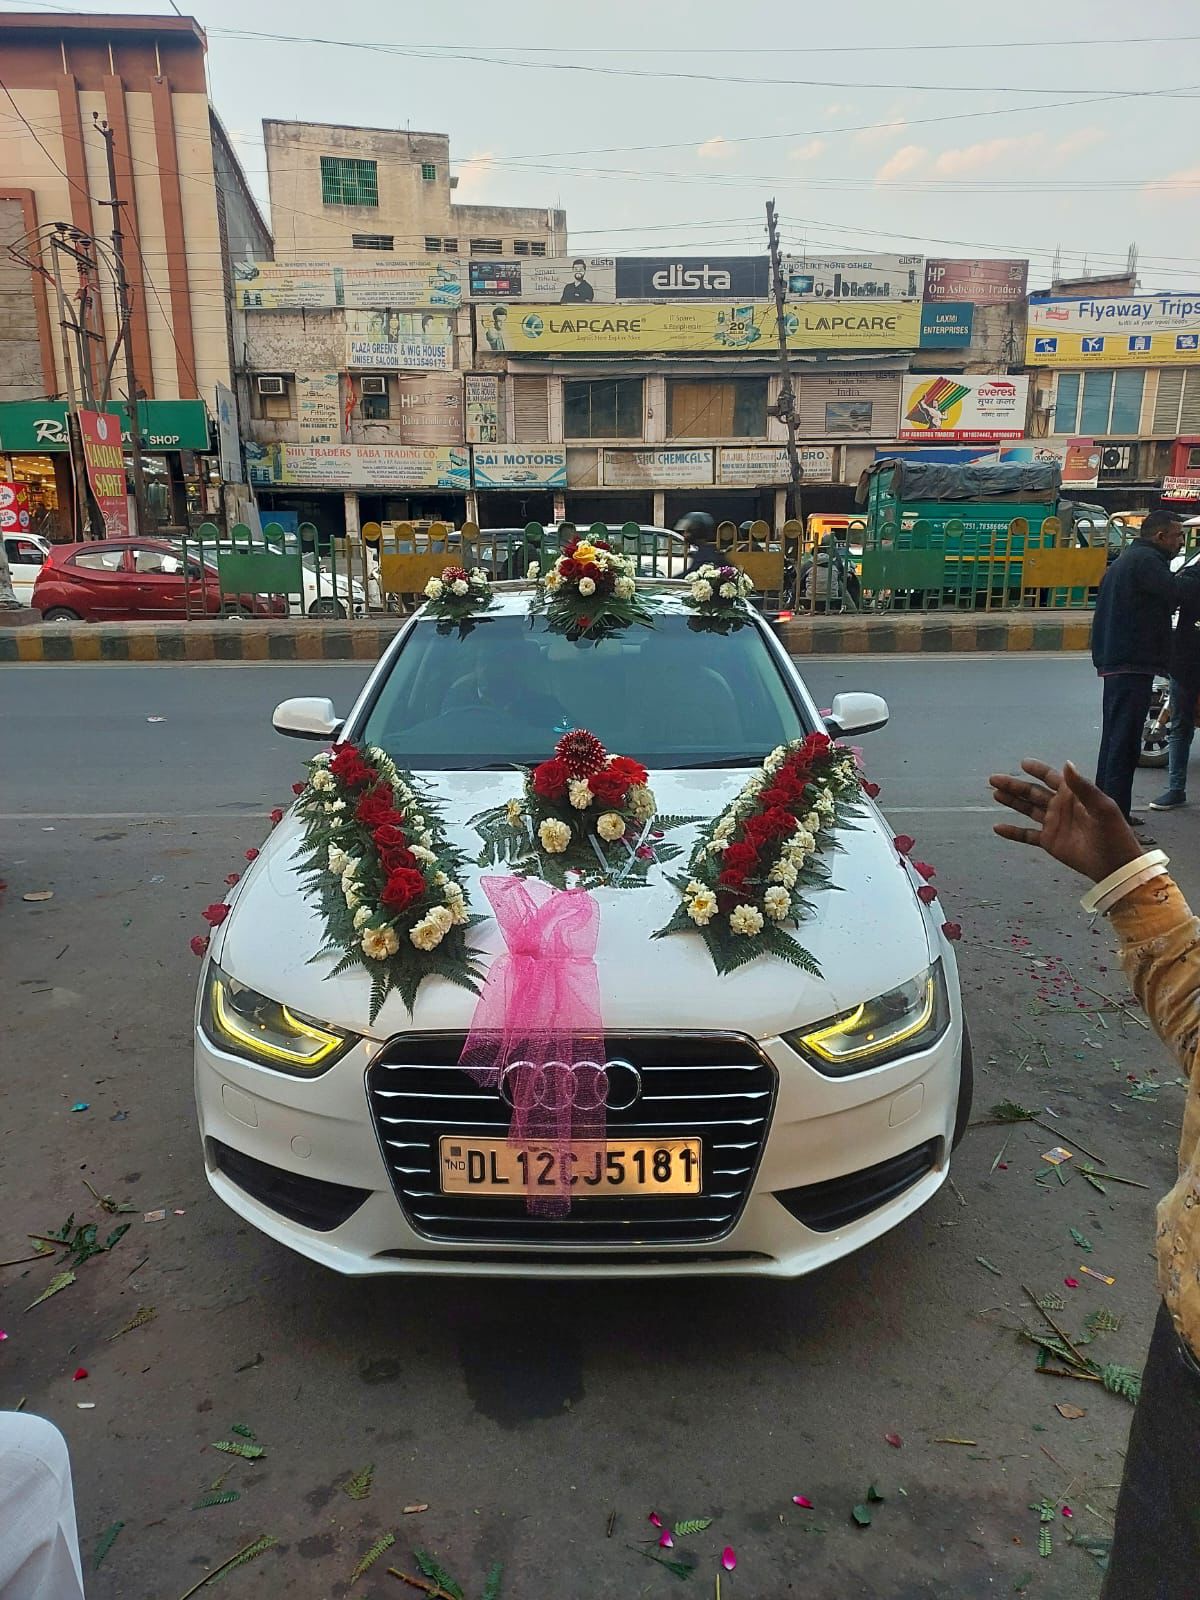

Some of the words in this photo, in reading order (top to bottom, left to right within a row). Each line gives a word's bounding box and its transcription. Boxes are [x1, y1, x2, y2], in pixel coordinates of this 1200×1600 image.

[590, 258, 614, 266] elista
[652, 264, 730, 290] elista
[928, 267, 945, 281] HP
[929, 284, 945, 294] Om
[947, 284, 985, 294] Asbestos
[989, 284, 1022, 294] Traders
[1079, 302, 1153, 322] Flyaway
[1158, 299, 1200, 318] Trips
[805, 317, 896, 330] LAPCARE
[936, 315, 958, 323] LAXMI
[550, 319, 641, 333] LAPCARE
[729, 322, 745, 331] 20
[923, 326, 969, 335] ENTERPRISES
[351, 342, 370, 354] PLAZA
[407, 345, 420, 357] WIG
[422, 345, 446, 358] HOUSE
[352, 355, 373, 364] UNISEX
[375, 356, 399, 366] SALOON
[978, 388, 1016, 396] everest
[33, 419, 70, 443] Rei
[149, 435, 180, 445] SHOP
[86, 443, 124, 468] VANDANA
[286, 448, 306, 456] SHIV
[310, 449, 351, 457] TRADERS
[357, 449, 380, 457] BABA
[384, 449, 420, 458] TRADING
[658, 453, 710, 464] CHEMICALS
[802, 452, 829, 460] BRO.
[475, 455, 498, 464] SAI
[504, 455, 563, 464] MOTORS
[95, 474, 123, 496] SAREE
[447, 1161, 465, 1171] IND
